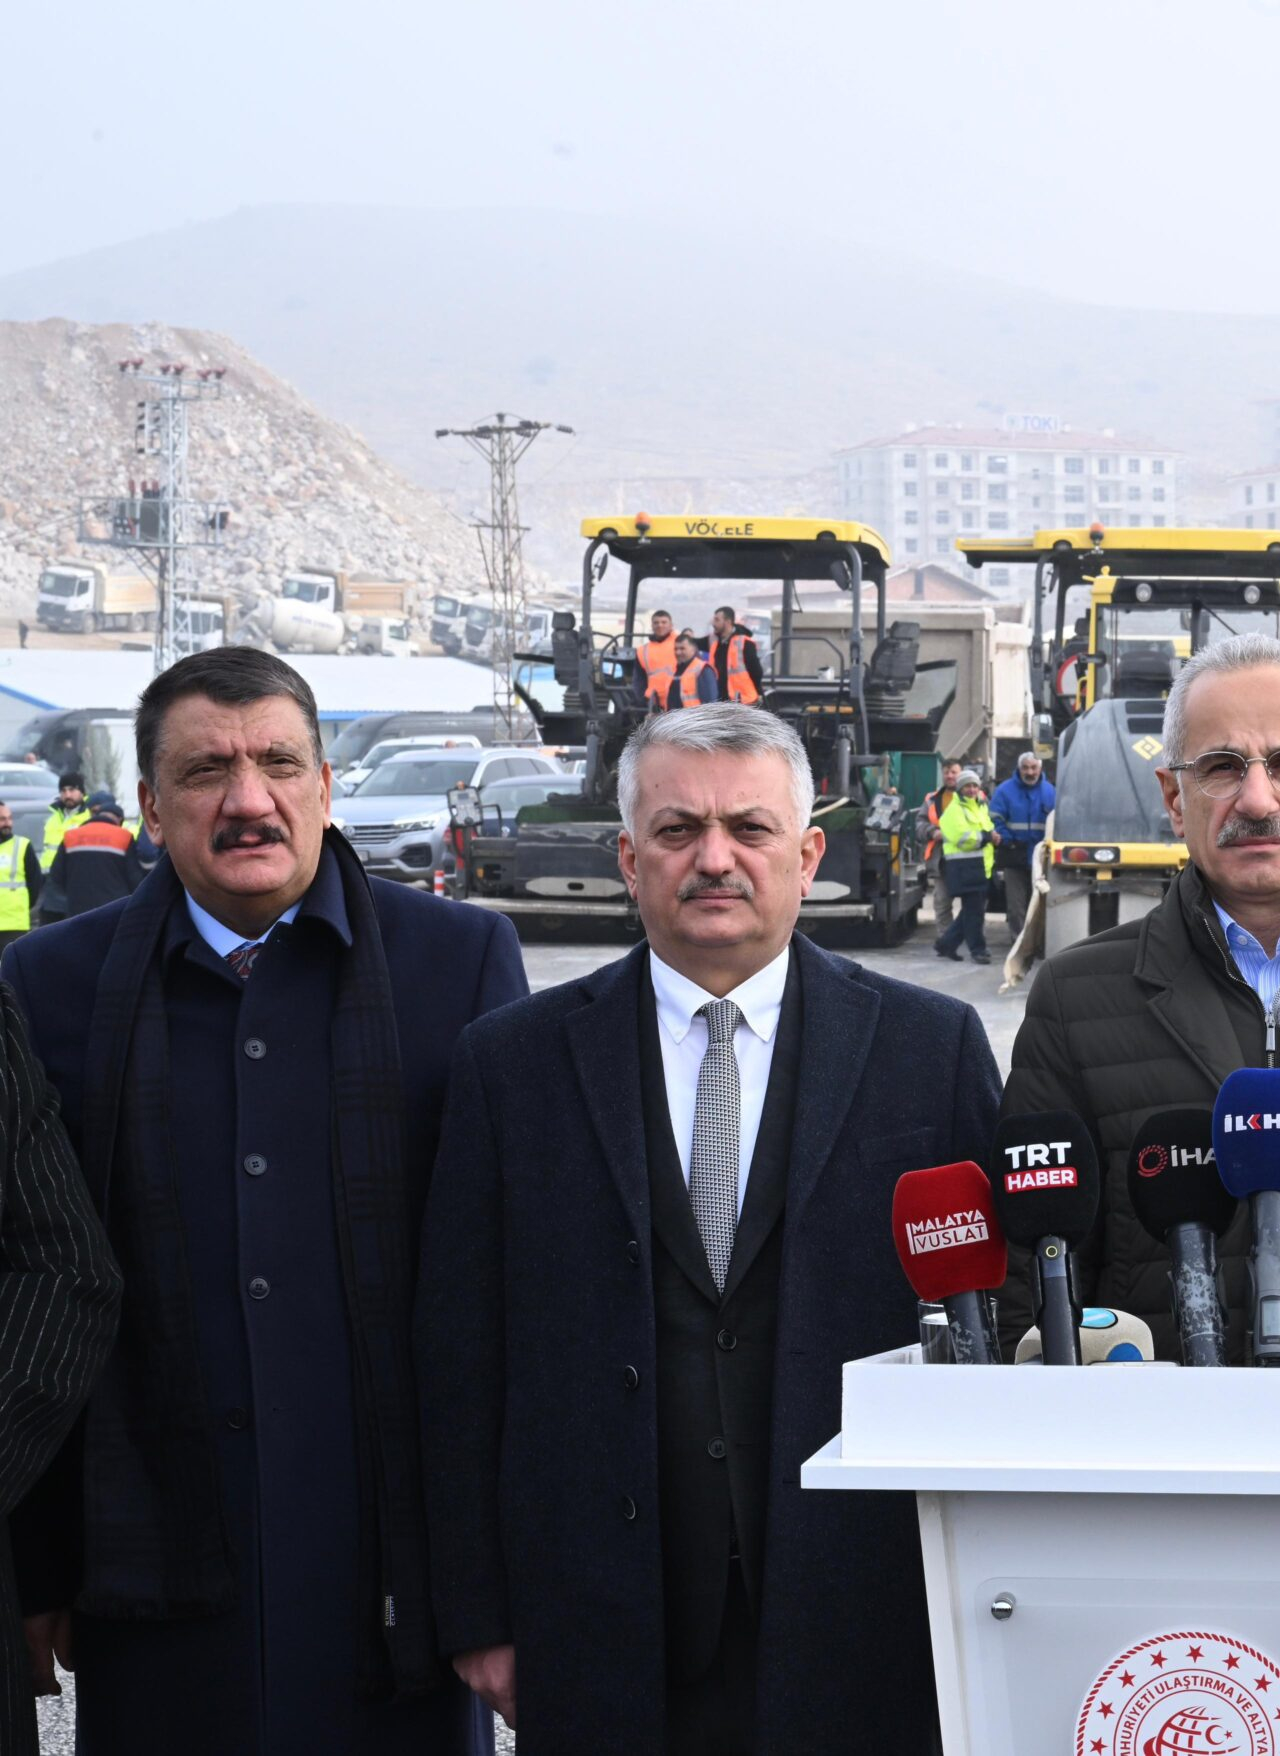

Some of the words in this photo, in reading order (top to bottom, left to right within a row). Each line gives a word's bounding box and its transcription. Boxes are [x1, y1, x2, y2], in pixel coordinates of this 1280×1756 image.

[1005, 1142, 1071, 1169] TRT
[1007, 1170, 1074, 1190] HABER
[912, 1209, 985, 1235] MALATYA
[916, 1225, 984, 1250] VUSLAT
[1154, 1675, 1234, 1698] ULAŞTIRMA
[1236, 1693, 1253, 1712] VE
[1247, 1712, 1268, 1755] ALTYA
